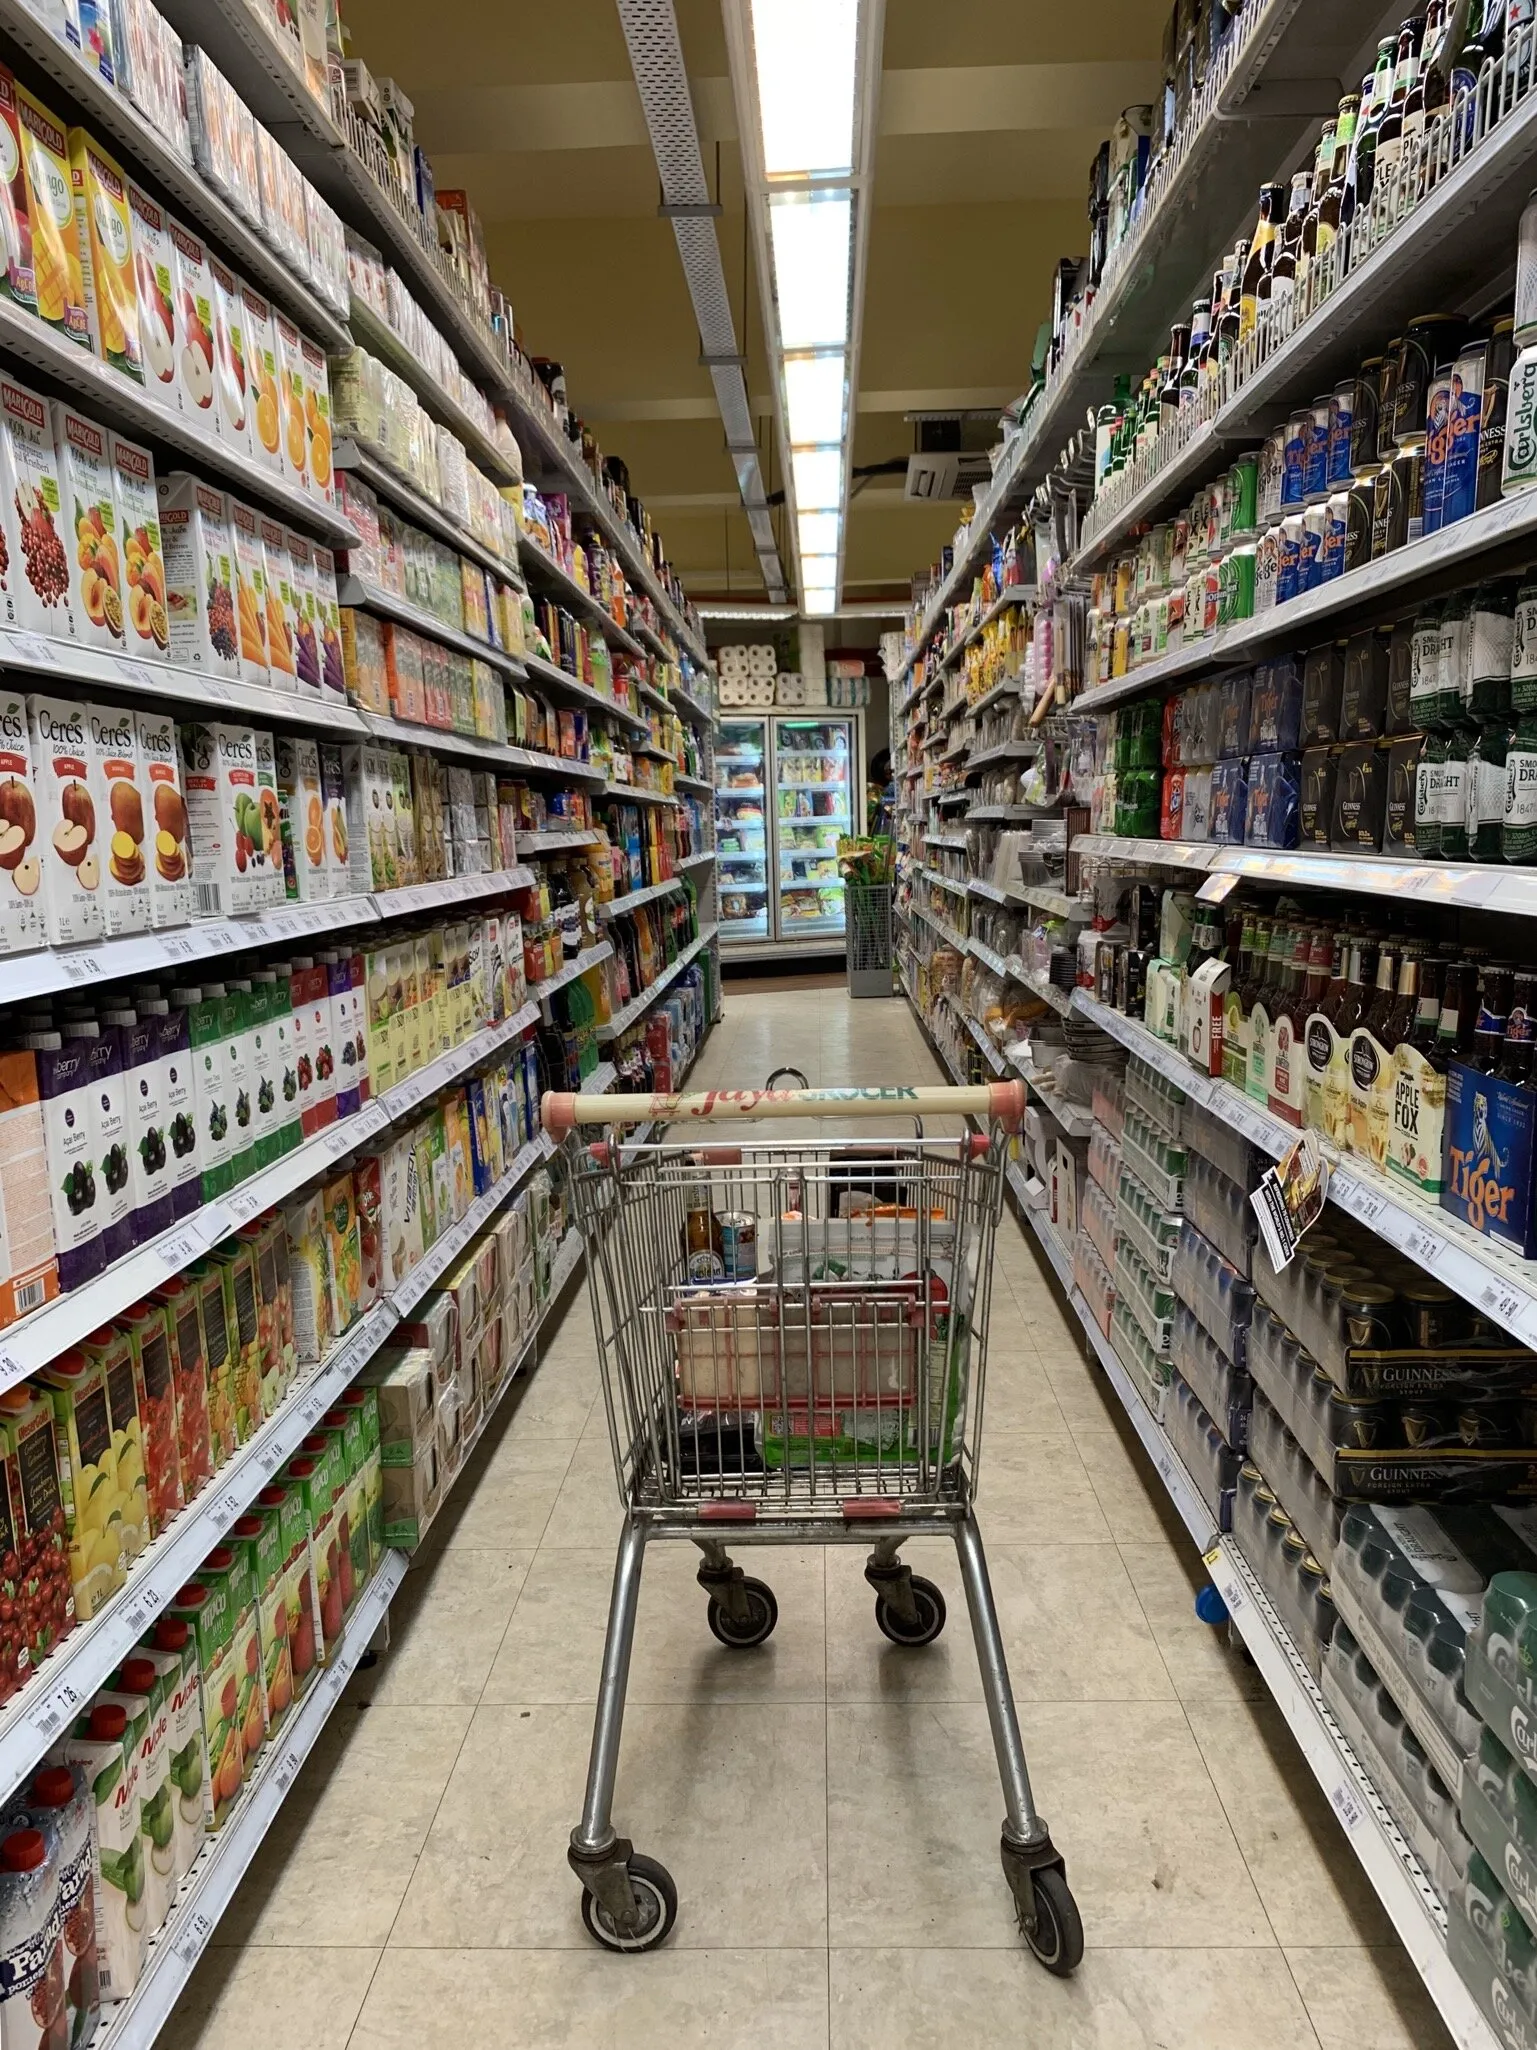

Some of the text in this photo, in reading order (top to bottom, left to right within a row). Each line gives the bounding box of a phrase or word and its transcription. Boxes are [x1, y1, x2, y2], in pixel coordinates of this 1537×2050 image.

[4, 388, 43, 418] MARIGOLD
[67, 419, 100, 448] MARIGOLD
[116, 446, 147, 472] MARIGOLD
[160, 510, 187, 523] RIGOLD
[40, 710, 83, 744] Ceres
[91, 717, 132, 747] Ceres
[140, 724, 171, 752] Ceres
[67, 745, 86, 757] Juice
[218, 733, 252, 758] Ceres
[1212, 1016, 1222, 1039] FREE
[57, 1056, 81, 1075] berry
[175, 1087, 187, 1099] Berry
[1396, 1080, 1420, 1109] APPLE
[147, 1100, 158, 1111] Berry
[110, 1115, 121, 1128] Berry
[1395, 1101, 1419, 1135] FOX
[73, 1130, 85, 1144] Berry
[1450, 1145, 1516, 1231] Tiger
[1370, 1467, 1443, 1481] GUINNESS
[143, 1589, 160, 1608] 6.23
[58, 1686, 77, 1709] 7.26
